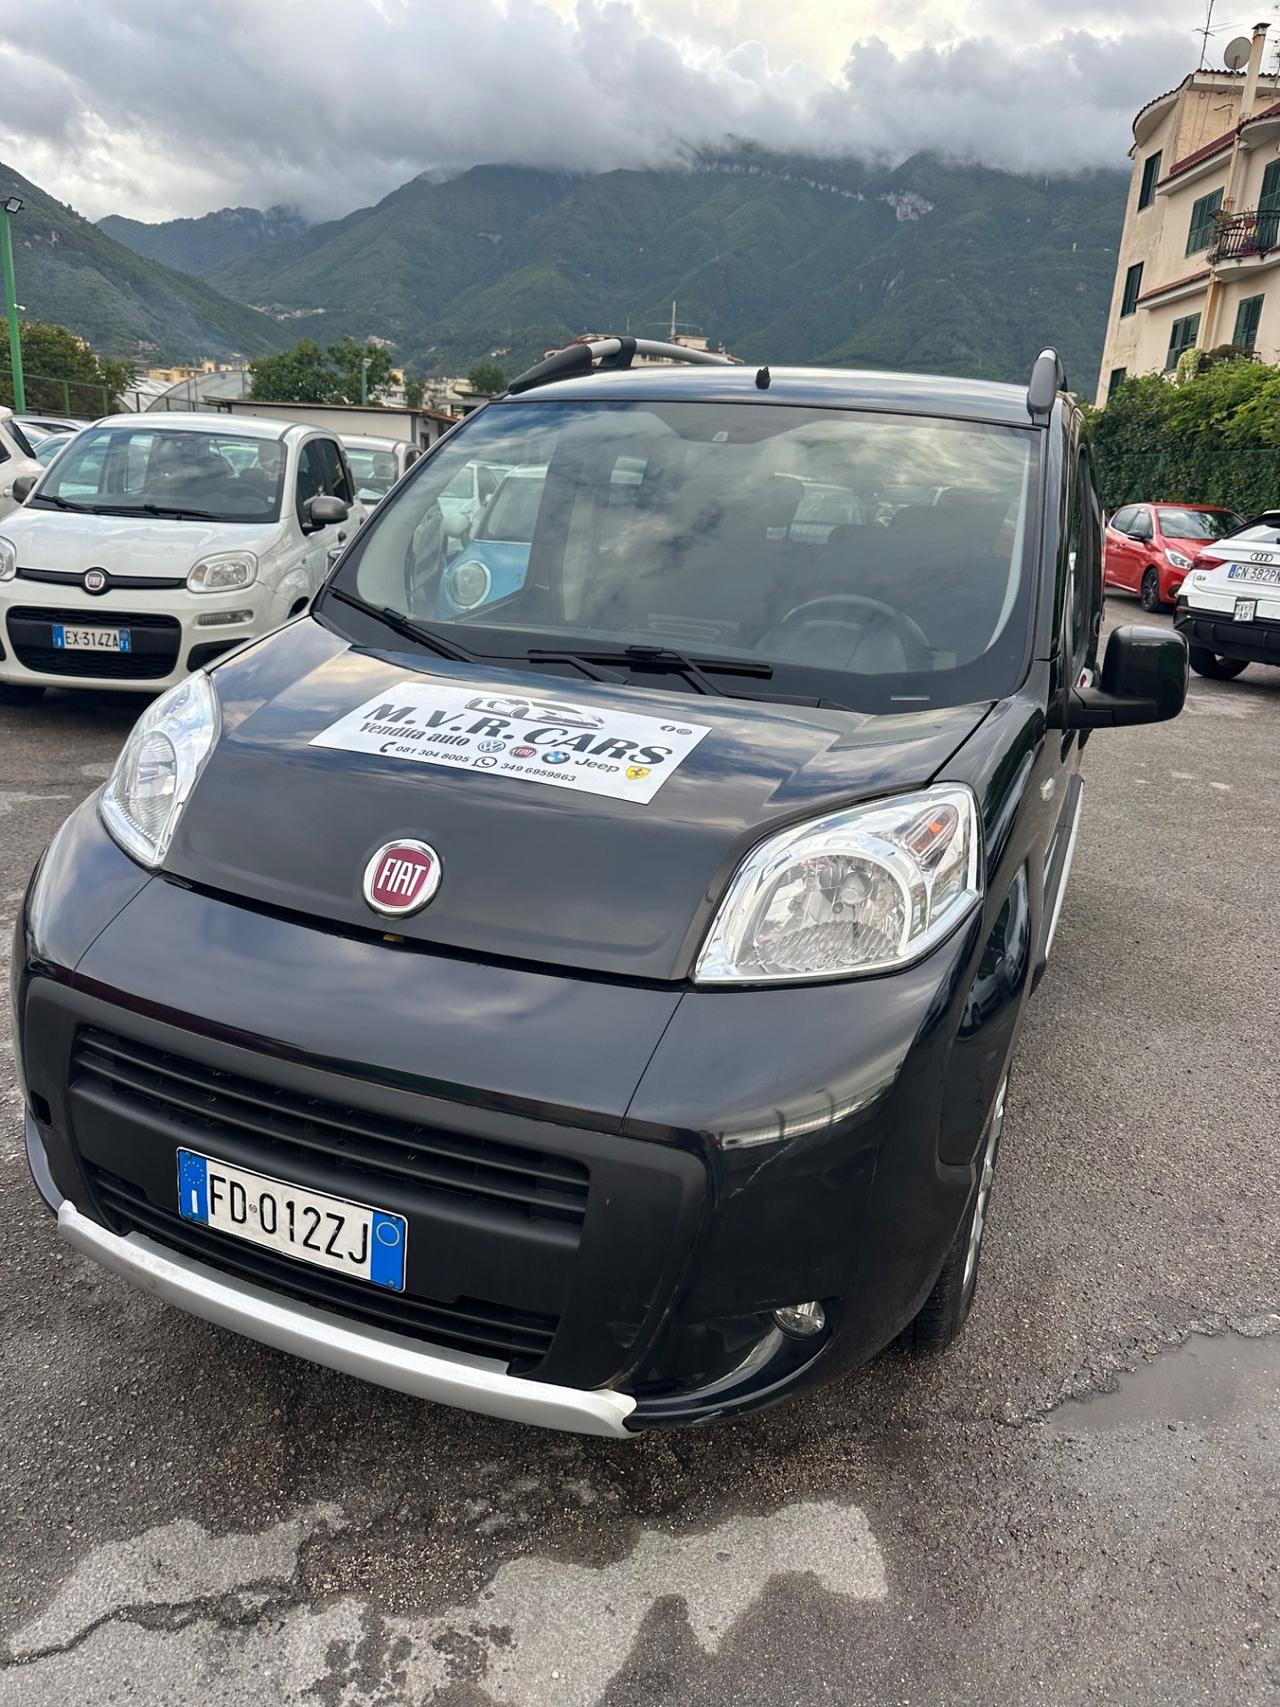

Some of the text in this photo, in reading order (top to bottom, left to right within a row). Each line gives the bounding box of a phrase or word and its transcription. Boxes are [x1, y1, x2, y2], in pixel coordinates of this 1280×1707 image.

[359, 722, 427, 741] Vendita
[427, 732, 471, 747] auto
[394, 745, 471, 763] 081 304 8005
[500, 762, 577, 783] 349 6959863
[575, 758, 620, 774] Jeep
[376, 857, 427, 897] FIAT
